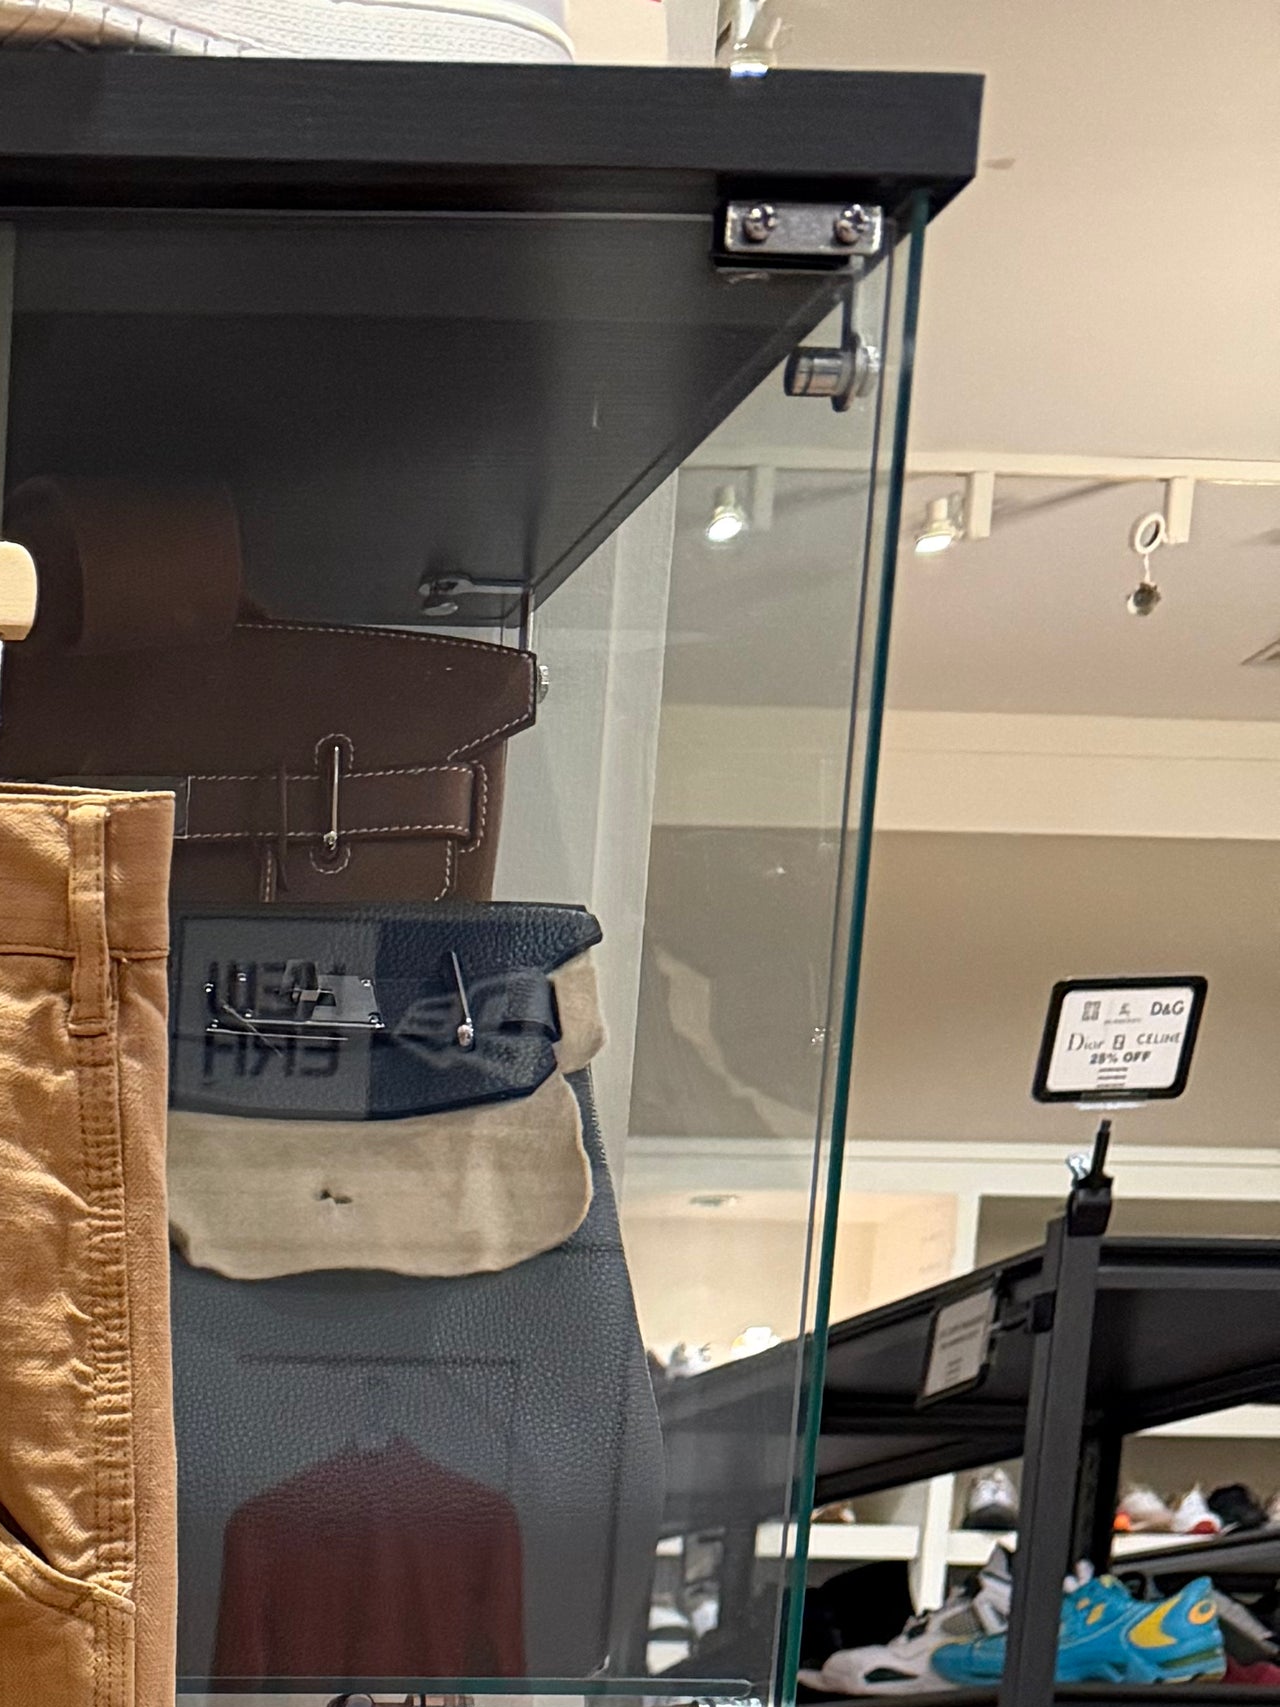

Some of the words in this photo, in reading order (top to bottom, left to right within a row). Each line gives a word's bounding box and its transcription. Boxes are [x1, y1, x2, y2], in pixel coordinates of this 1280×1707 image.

[1150, 1000, 1185, 1016] D&G
[1067, 1033, 1105, 1051] Dior
[1136, 1032, 1182, 1045] CELINE
[1123, 1051, 1151, 1063] OFF
